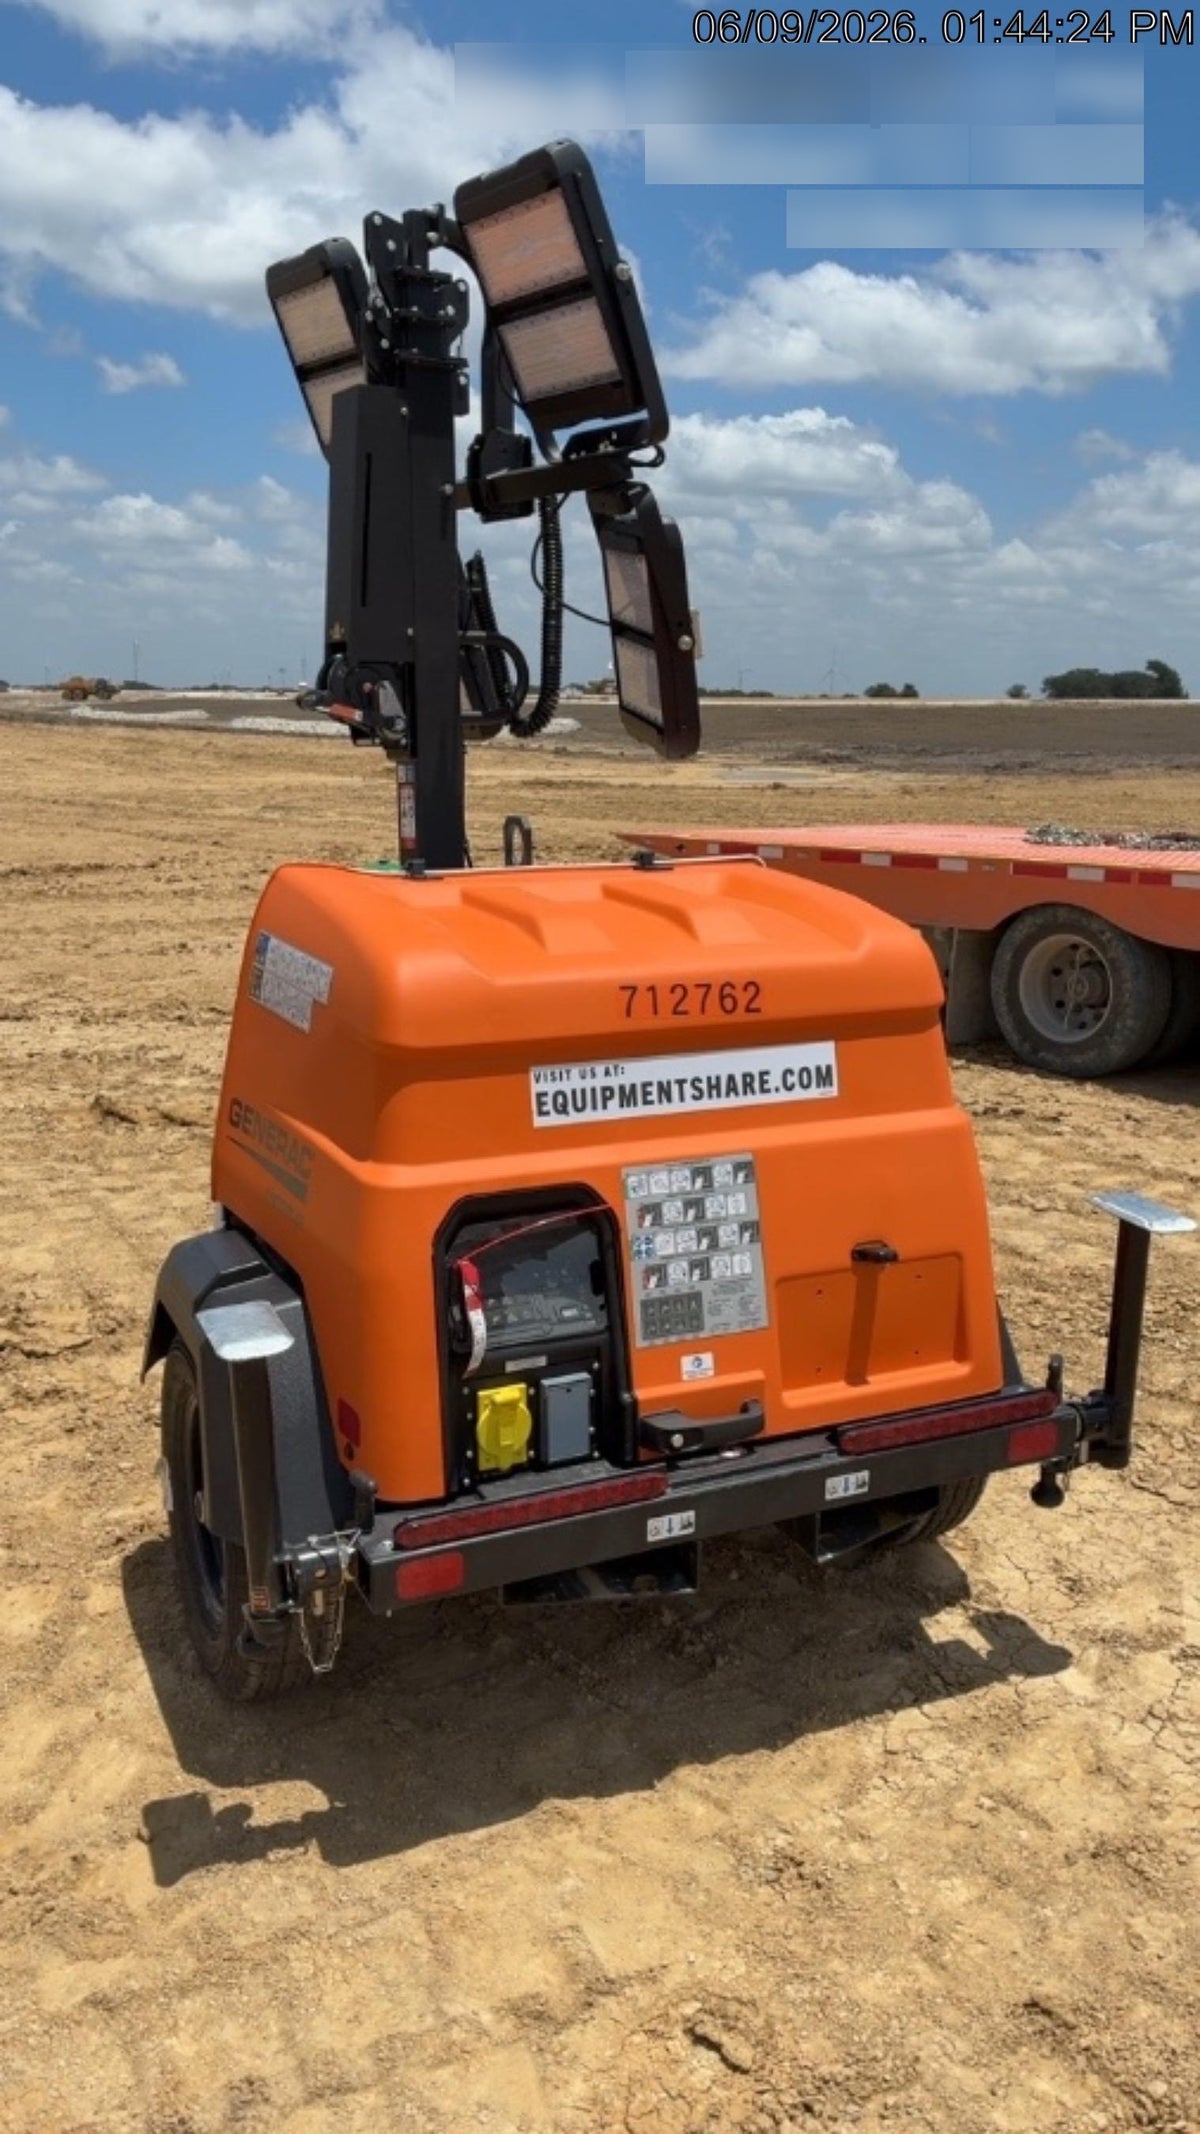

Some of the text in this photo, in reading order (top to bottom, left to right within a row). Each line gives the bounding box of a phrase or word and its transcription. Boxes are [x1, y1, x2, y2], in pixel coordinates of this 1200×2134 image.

[619, 981, 762, 1018] 712762
[533, 1064, 625, 1084] VISIT US AT:
[536, 1064, 834, 1117] EQUIPMENTSHARE.COM
[229, 1097, 314, 1178] GENERAC
